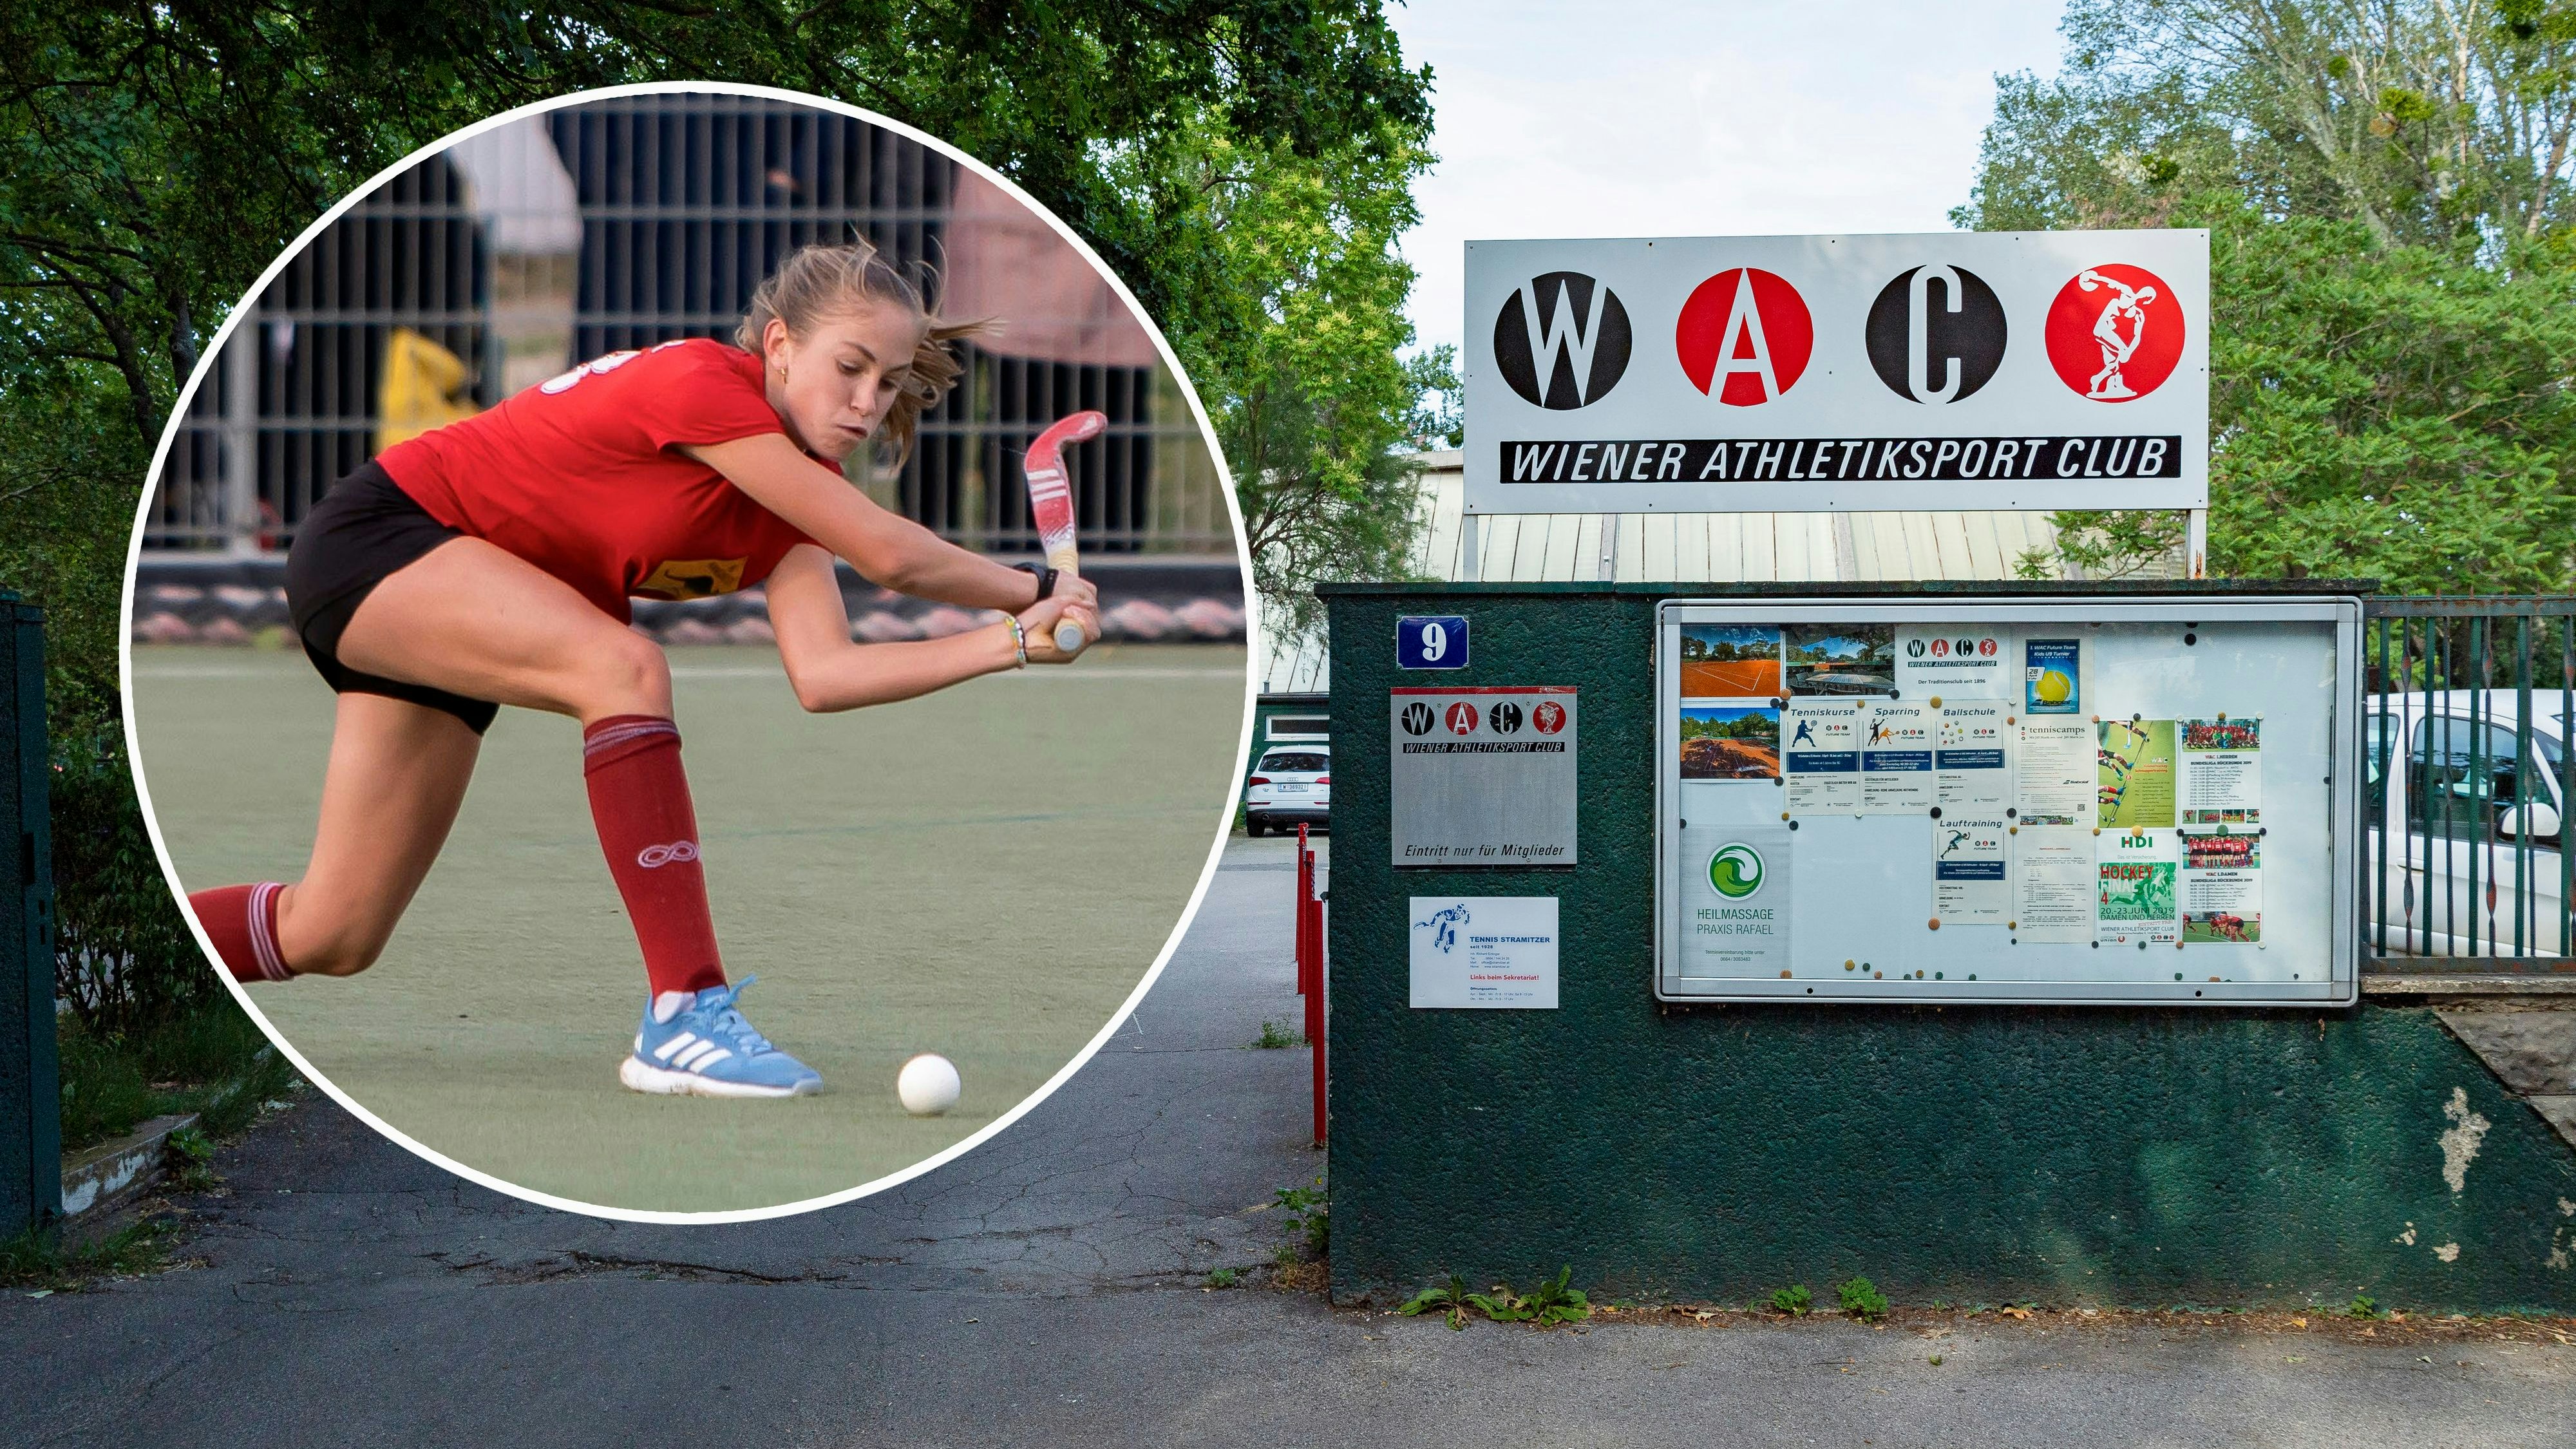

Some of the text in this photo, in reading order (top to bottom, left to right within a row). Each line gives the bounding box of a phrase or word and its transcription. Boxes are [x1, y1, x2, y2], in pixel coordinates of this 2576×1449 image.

[1511, 439, 2166, 480] WIENER ATHLETIKSPORT CLUB
[1422, 623, 1446, 661] 9
[2030, 726, 2085, 735] tenniscamps
[1405, 743, 1562, 753] WIENER ATHLETIKSPORT CLUB
[1940, 820, 2002, 828] Lauftraining
[2121, 837, 2152, 848] HDI
[1405, 844, 1565, 858] Eintritt nur für Mitglieder
[2100, 866, 2154, 879] HOCKEY
[2101, 879, 2139, 893] FINAL
[2101, 892, 2108, 905] 4
[1698, 909, 1774, 919] HEILMASSAGE
[1697, 924, 1774, 934] PRAXIS RAFAEL
